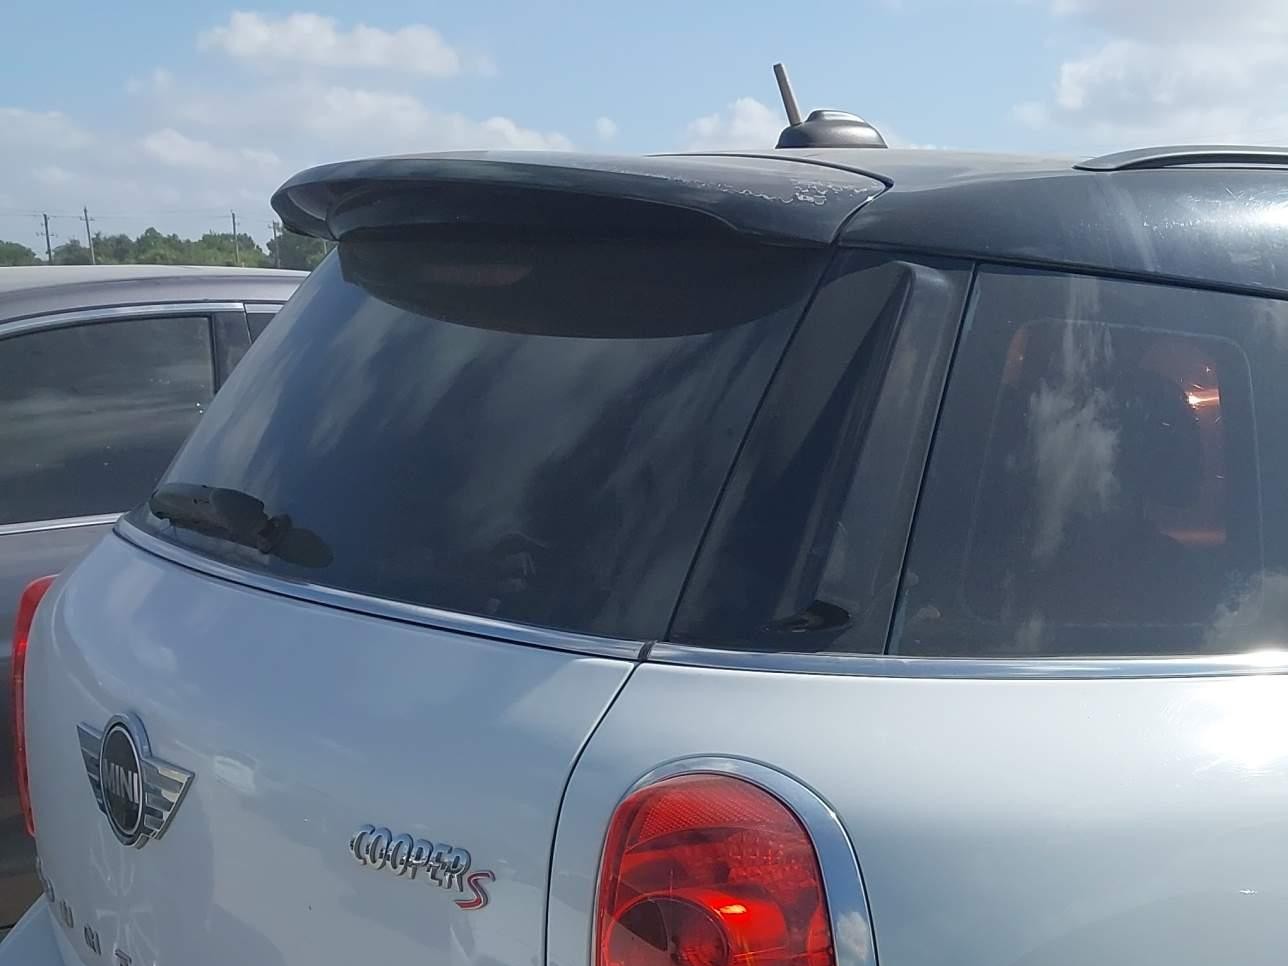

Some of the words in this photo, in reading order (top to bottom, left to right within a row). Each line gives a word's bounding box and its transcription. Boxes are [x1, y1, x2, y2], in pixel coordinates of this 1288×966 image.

[103, 757, 140, 804] MINI
[350, 823, 471, 892] COOPER
[454, 869, 496, 911] S
